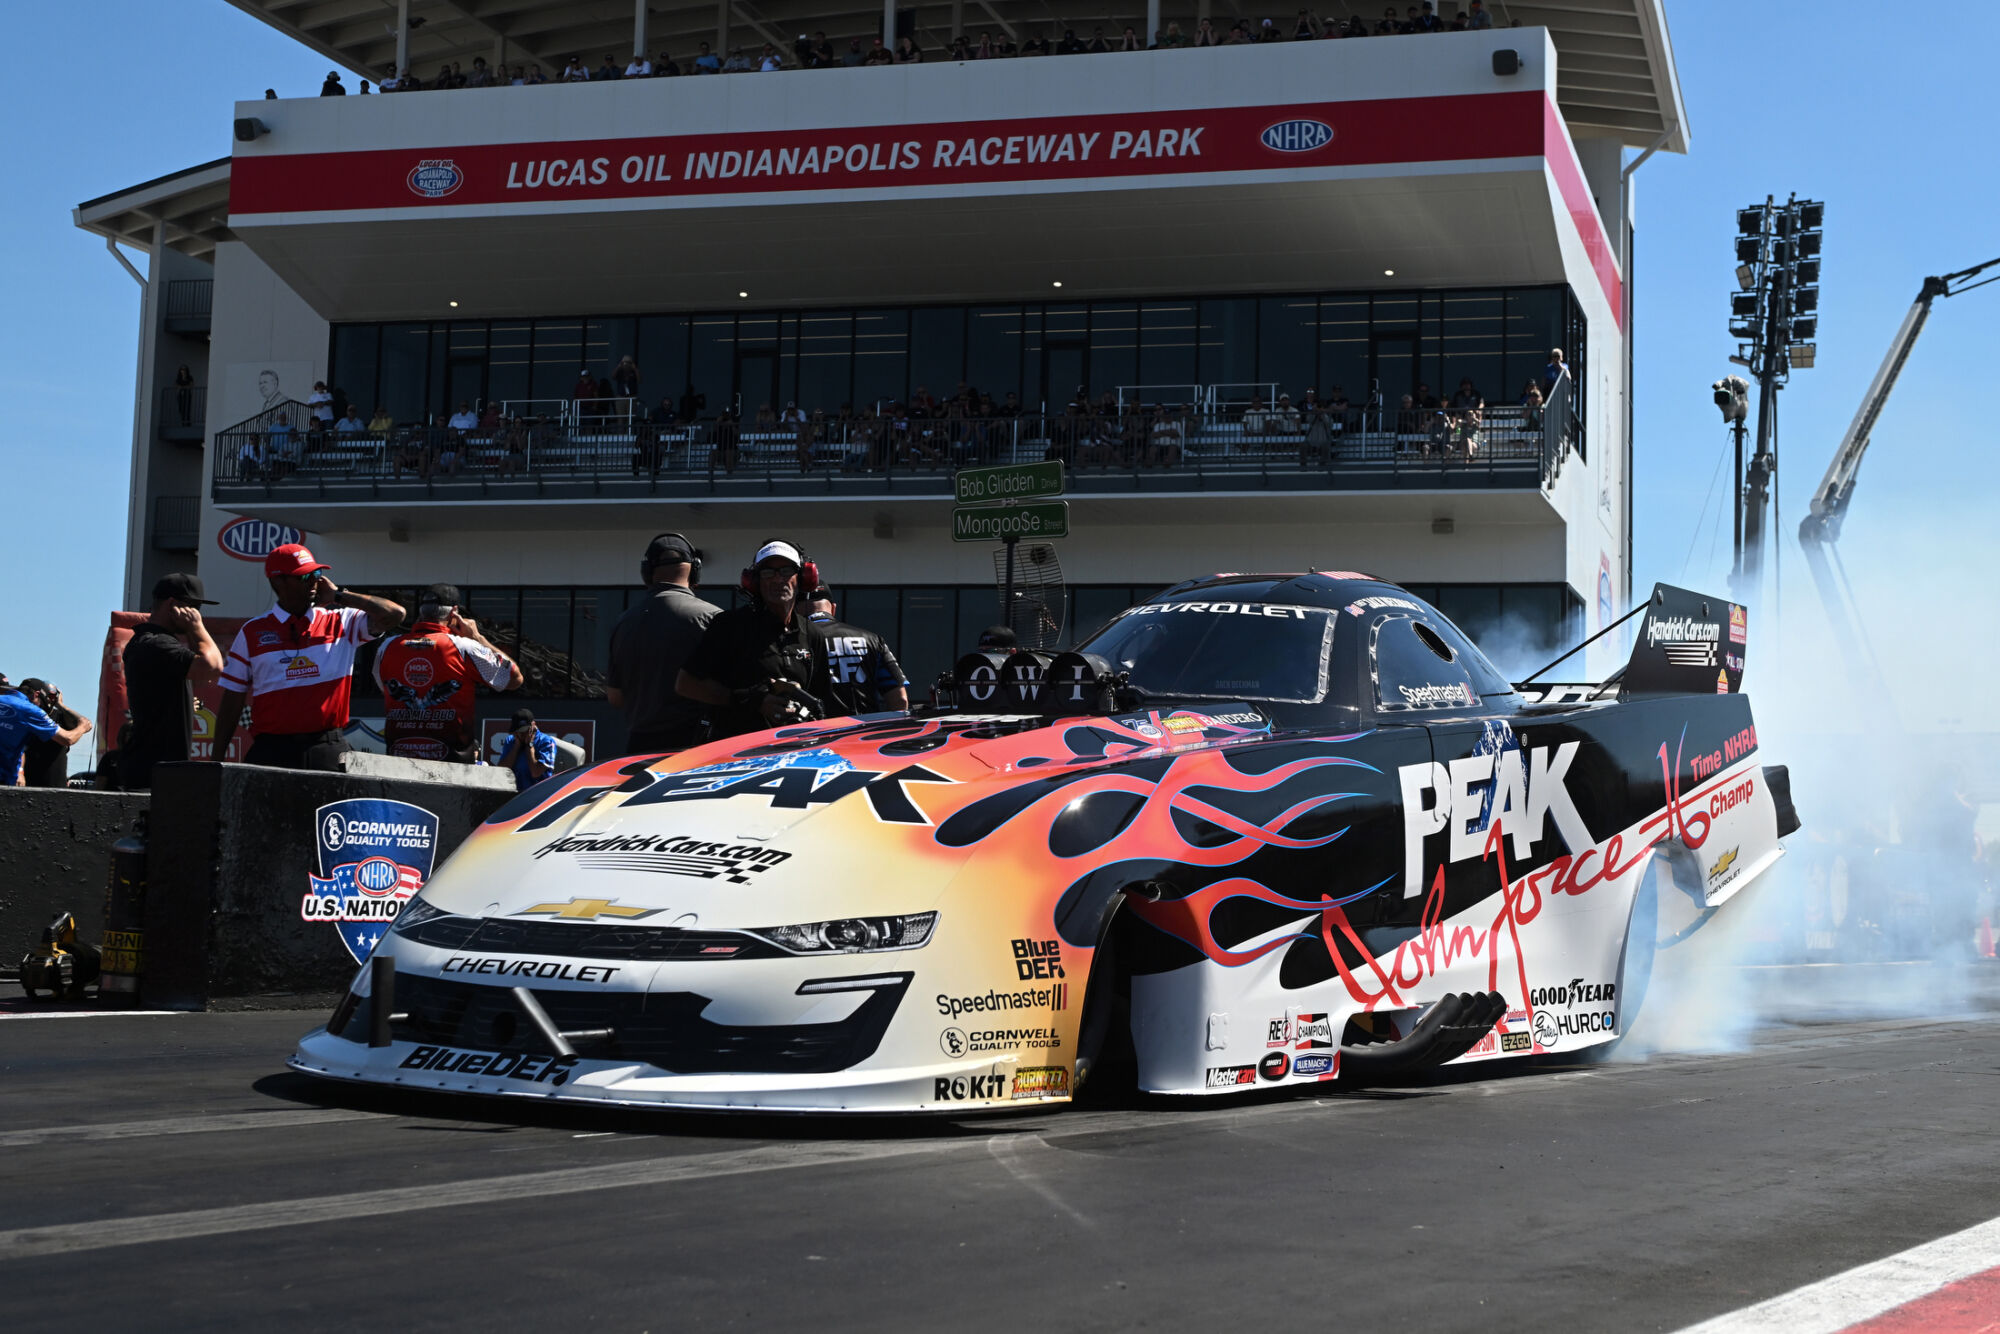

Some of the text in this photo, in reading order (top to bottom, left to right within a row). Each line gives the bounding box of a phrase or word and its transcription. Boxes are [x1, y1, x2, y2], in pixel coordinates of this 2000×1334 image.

[1268, 121, 1330, 150] NHRA
[420, 160, 440, 168] LUCAS
[506, 126, 1205, 190] LUCAS OIL INDIANAPOLIS RACEWAY PARK
[418, 168, 453, 179] INDIANAPOLIS
[419, 179, 451, 189] RACEWAY
[960, 477, 985, 498] Bob
[987, 472, 1035, 495] Glidden
[231, 521, 293, 554] NHRA
[825, 637, 868, 656] ue
[409, 664, 429, 672] NGK
[1398, 682, 1466, 706] Speedmaster
[1198, 712, 1263, 726] BANDERO
[1690, 725, 1758, 782] Time NHRA
[513, 763, 956, 834] PEAK
[1710, 778, 1754, 820] Champ
[347, 821, 430, 838] CORNWELL
[1398, 741, 1598, 900] PEAK
[346, 835, 431, 848] QUALITY TOOLS
[361, 862, 395, 889] NHRA
[1705, 867, 1742, 899] CHEVROLET
[304, 898, 340, 917] U.S.
[1011, 938, 1060, 959] Blue
[441, 957, 621, 983] CHEVROLET
[1015, 957, 1062, 981] DEF
[936, 988, 1052, 1020] Speedmaster
[969, 1028, 1060, 1041] CORNWELL
[1298, 1025, 1329, 1039] CHAMPION
[1556, 1011, 1616, 1036] HURCO
[969, 1039, 1061, 1051] QUALITY TOOLS
[1207, 1068, 1256, 1088] Mastercam
